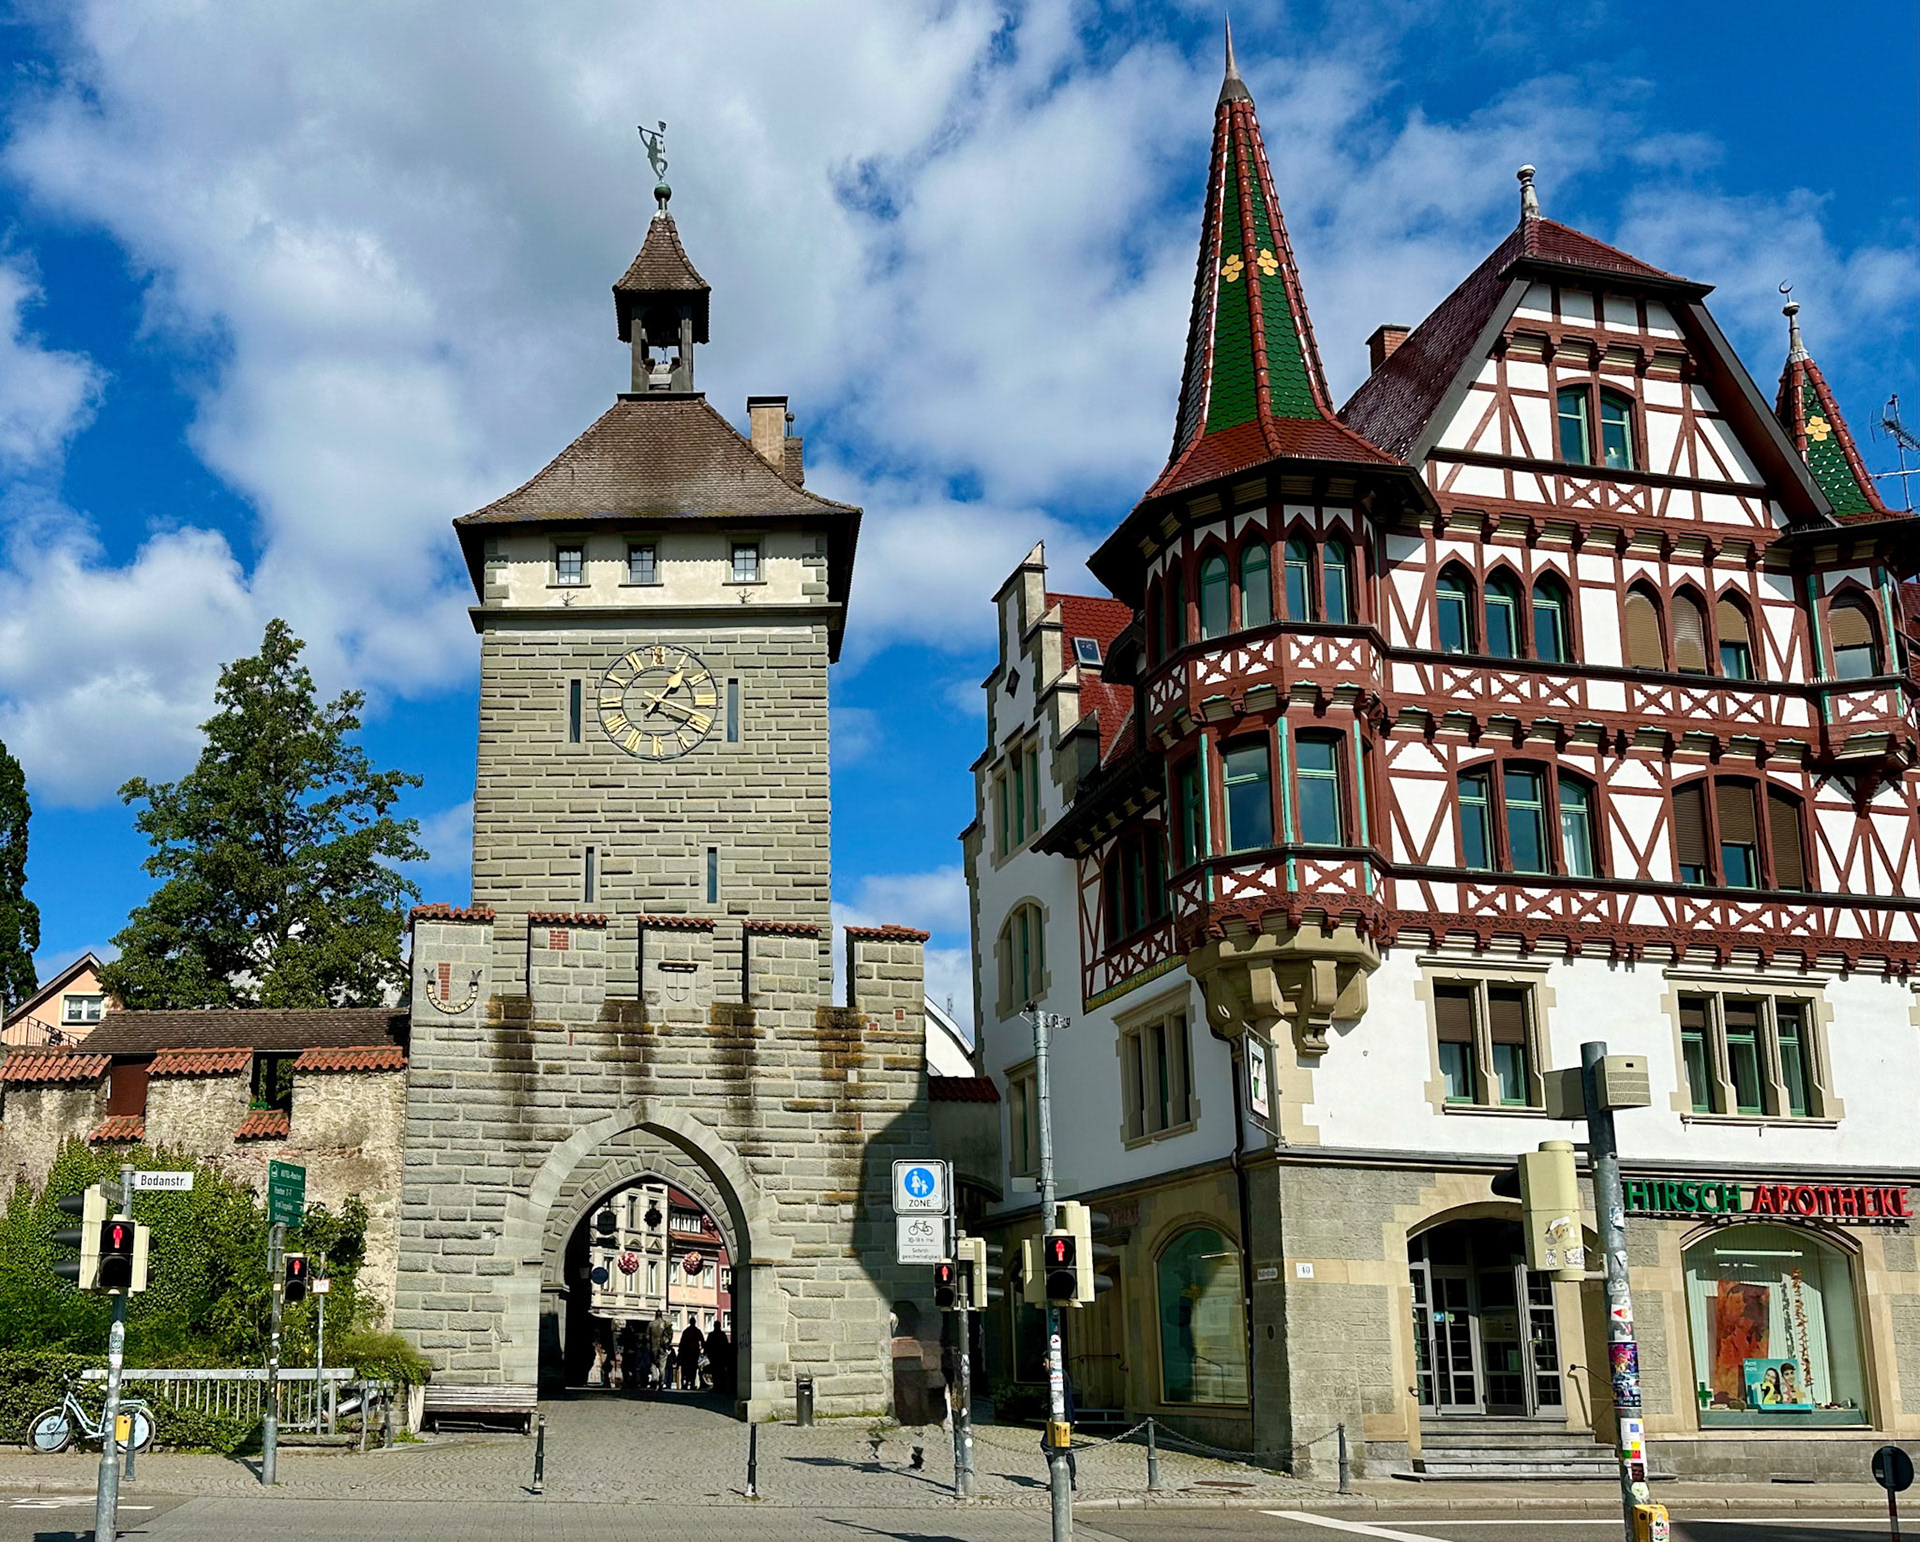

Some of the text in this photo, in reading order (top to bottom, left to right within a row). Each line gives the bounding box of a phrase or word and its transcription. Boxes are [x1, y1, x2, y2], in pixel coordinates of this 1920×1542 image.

[140, 1174, 186, 1187] Bodanstr.
[908, 1199, 932, 1208] ZONE
[1625, 1180, 1914, 1217] HIRSCH APOTHEKE
